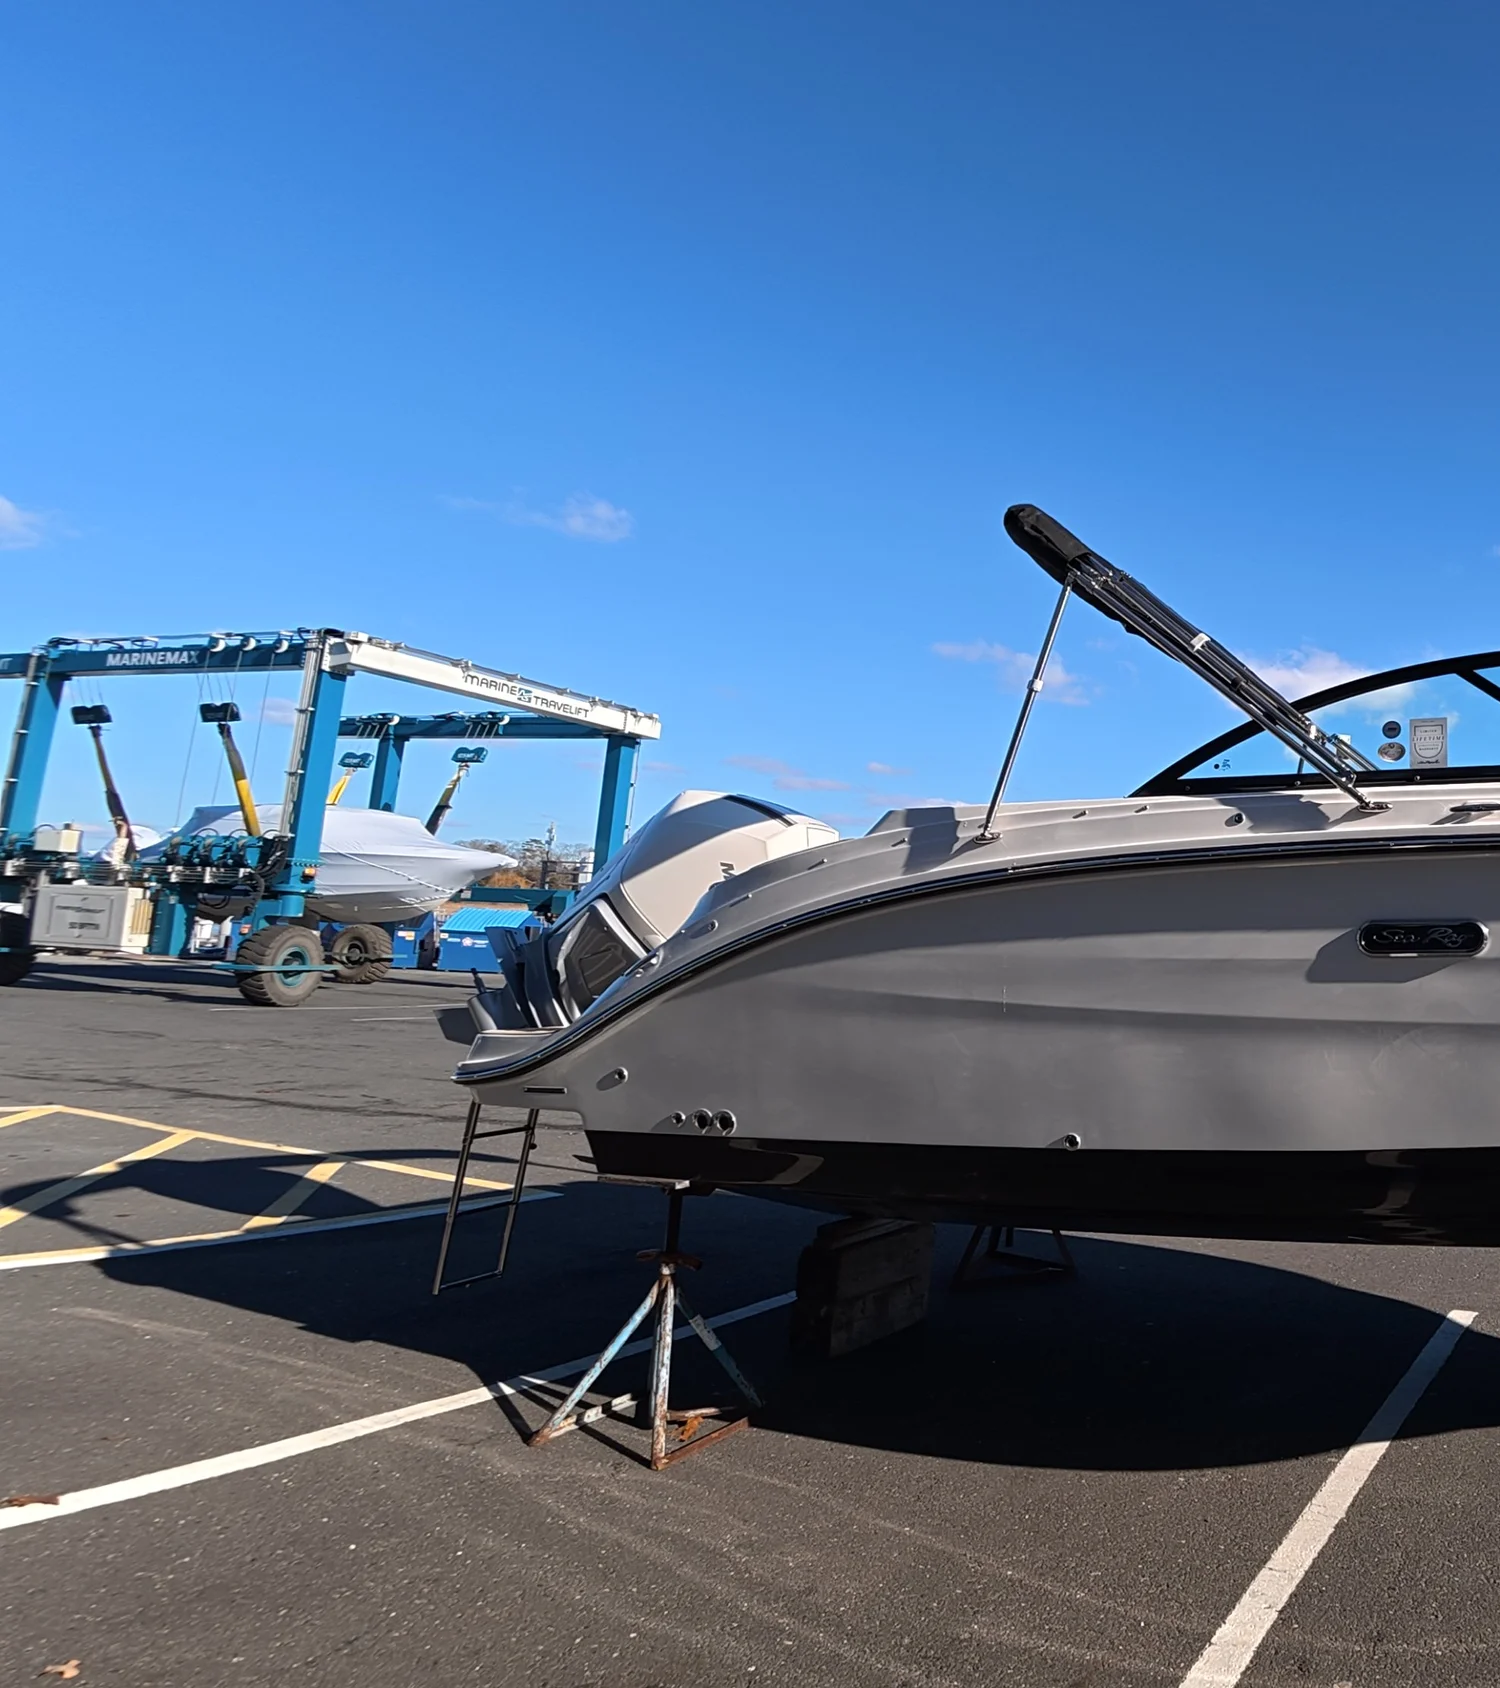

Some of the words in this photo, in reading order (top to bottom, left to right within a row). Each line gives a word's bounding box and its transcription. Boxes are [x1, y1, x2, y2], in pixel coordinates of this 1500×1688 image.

[106, 651, 200, 667] MARINEMAX
[464, 674, 518, 696] MARINE
[533, 695, 589, 718] TRAVELIFT
[1373, 929, 1420, 944] Sea
[1422, 927, 1475, 948] Ray
